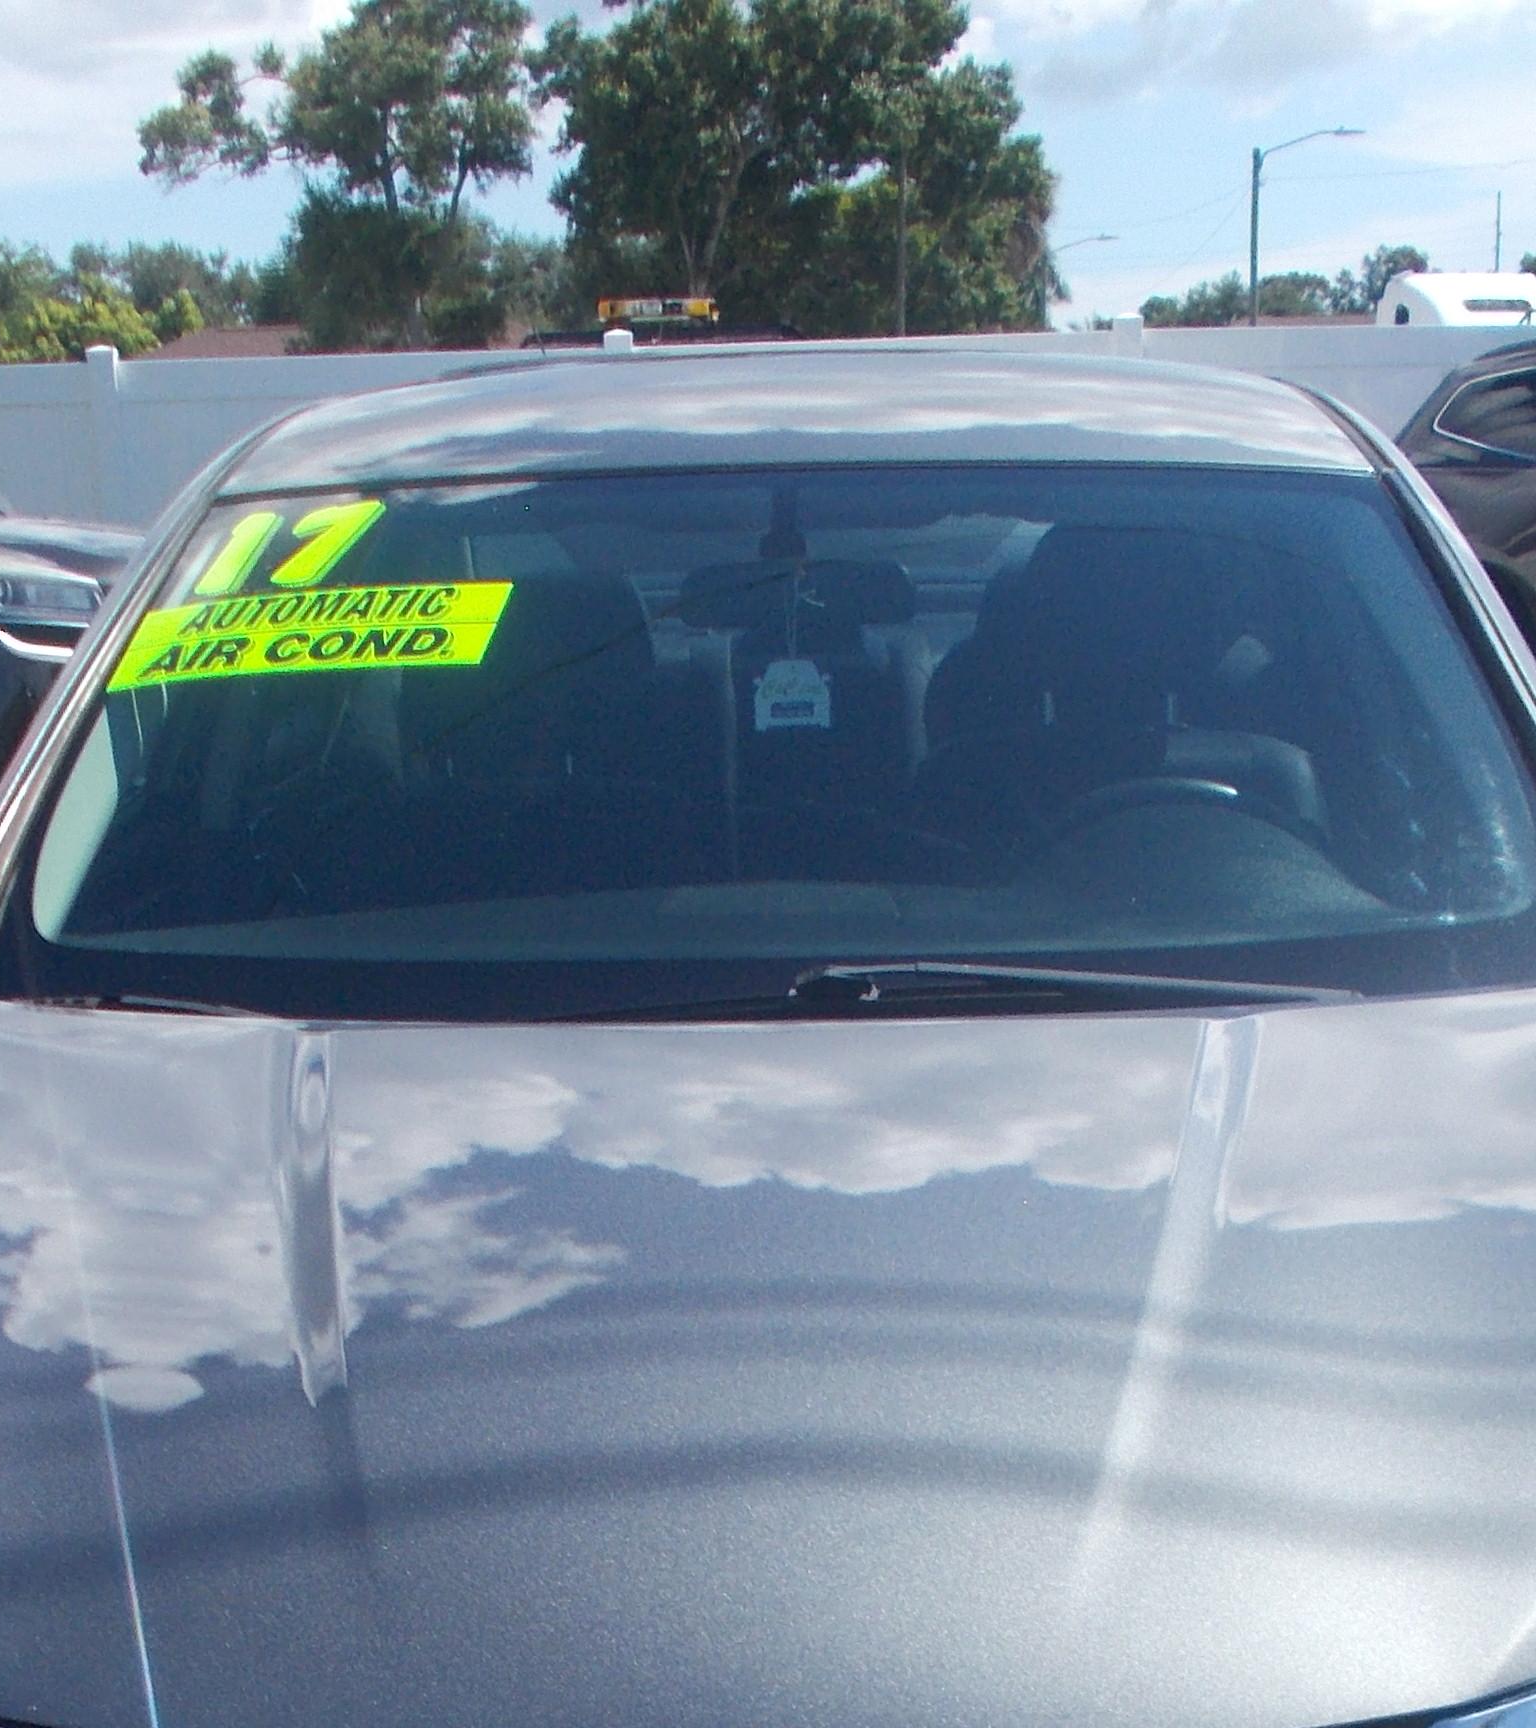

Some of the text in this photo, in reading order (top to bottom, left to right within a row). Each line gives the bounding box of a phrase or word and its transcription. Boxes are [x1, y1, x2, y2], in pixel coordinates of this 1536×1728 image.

[194, 498, 386, 596] 17
[179, 586, 462, 637] AUTOMATIC
[138, 625, 455, 680] AIR COND.
